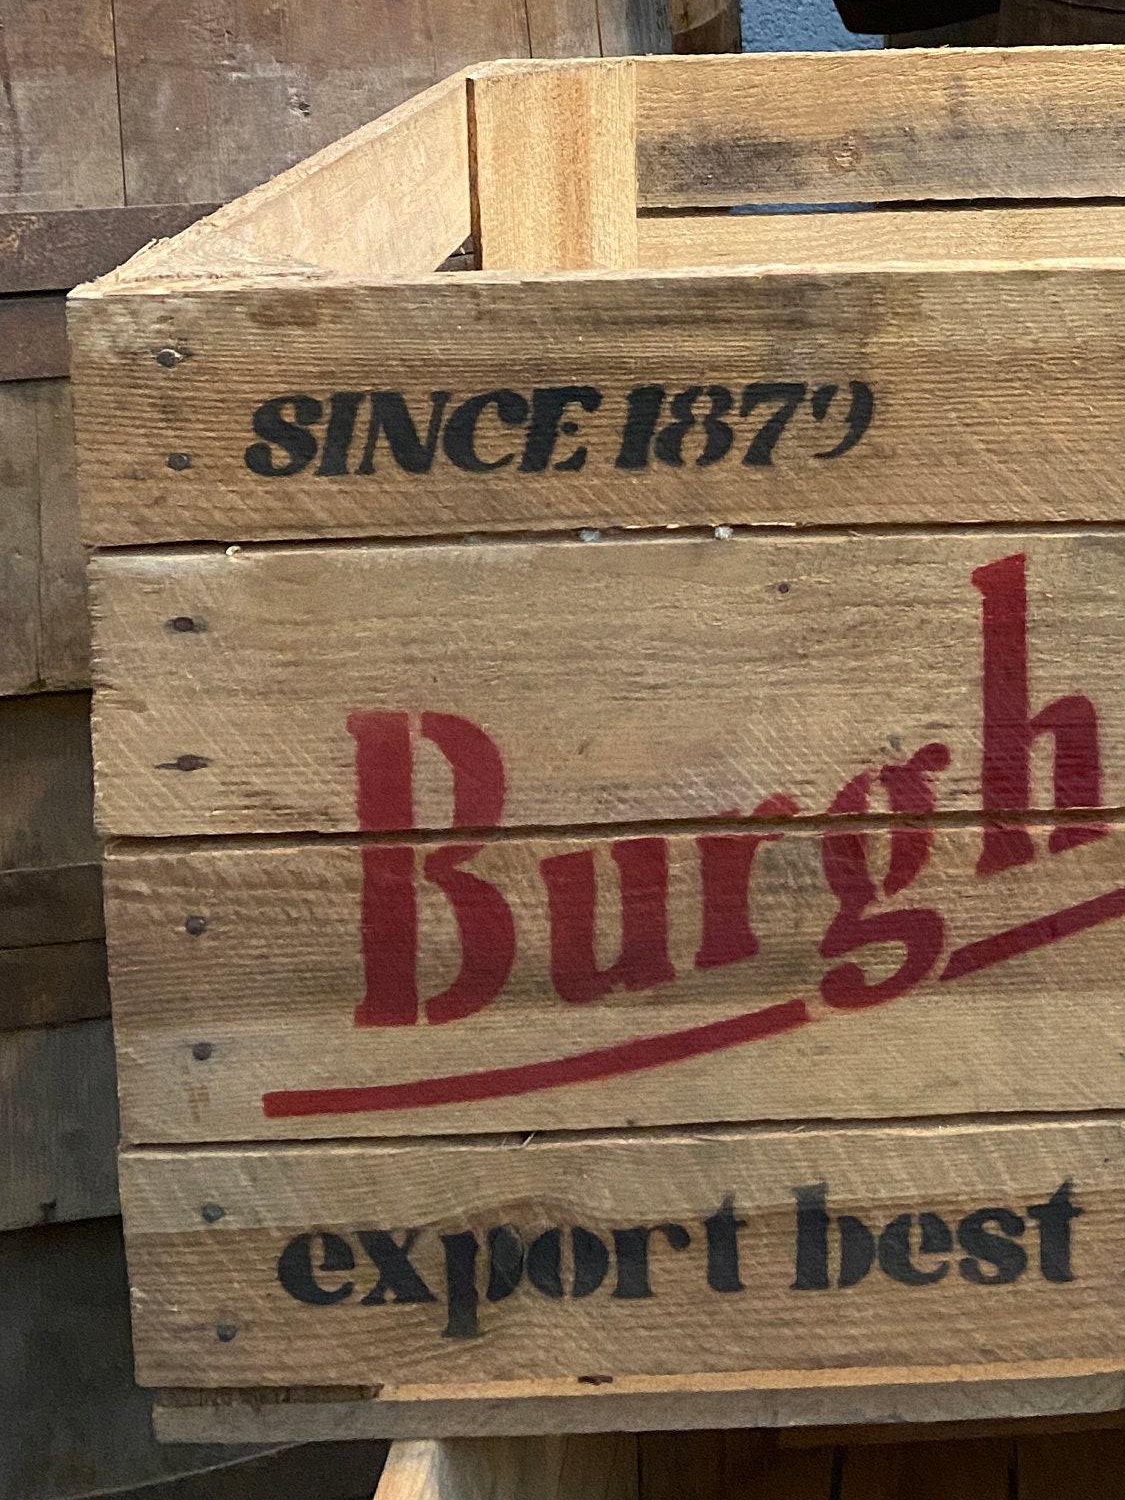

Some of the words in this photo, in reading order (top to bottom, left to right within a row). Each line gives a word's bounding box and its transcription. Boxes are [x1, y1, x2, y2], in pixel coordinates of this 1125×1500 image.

[244, 385, 600, 478] SINCE
[614, 379, 876, 469] 1879
[277, 1193, 748, 1339] export
[791, 1180, 1084, 1292] best
